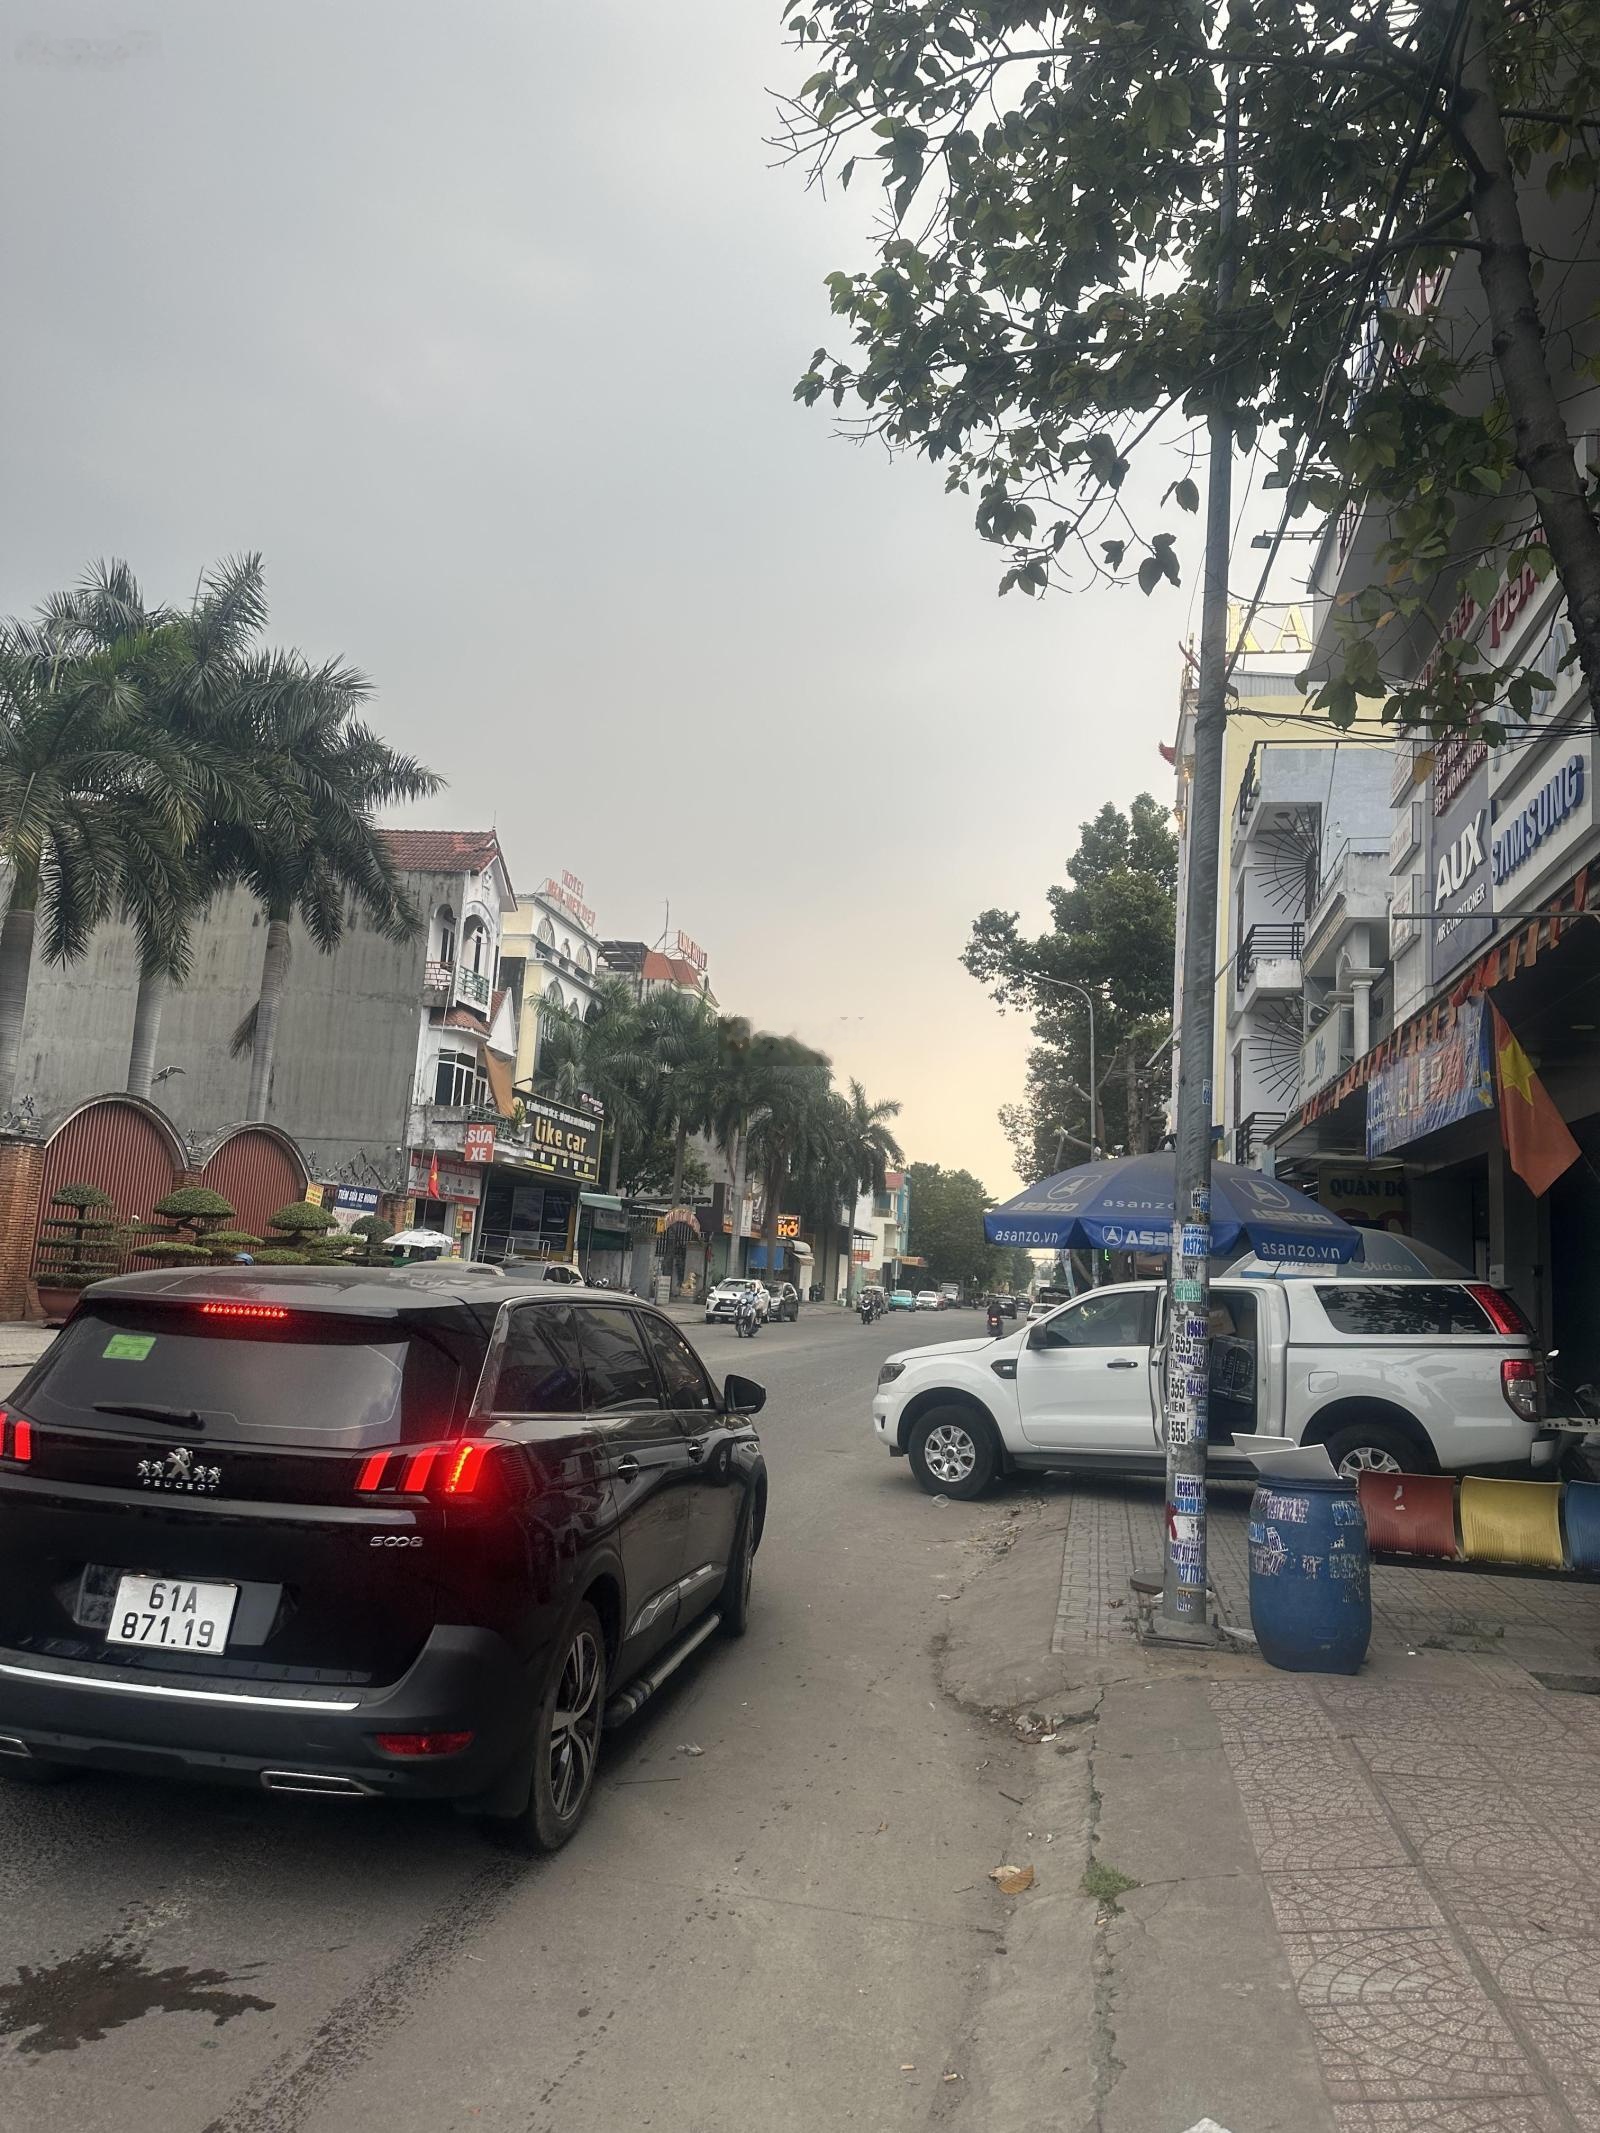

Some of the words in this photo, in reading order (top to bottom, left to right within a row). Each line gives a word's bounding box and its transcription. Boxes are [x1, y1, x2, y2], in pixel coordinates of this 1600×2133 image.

[1491, 755, 1584, 885] SAMSUNG
[1434, 808, 1486, 911] AUX
[468, 1125, 493, 1144] SỬA
[535, 1116, 563, 1147] like
[566, 1132, 587, 1153] car
[470, 1148, 487, 1161] XE
[995, 1228, 1059, 1245] asanzo.vn
[1262, 1241, 1341, 1260] asanzo.vn
[143, 1479, 217, 1492] PEUGEOT
[369, 1535, 424, 1549] 5008
[149, 1582, 198, 1614] 61A
[121, 1613, 215, 1648] 871.19
